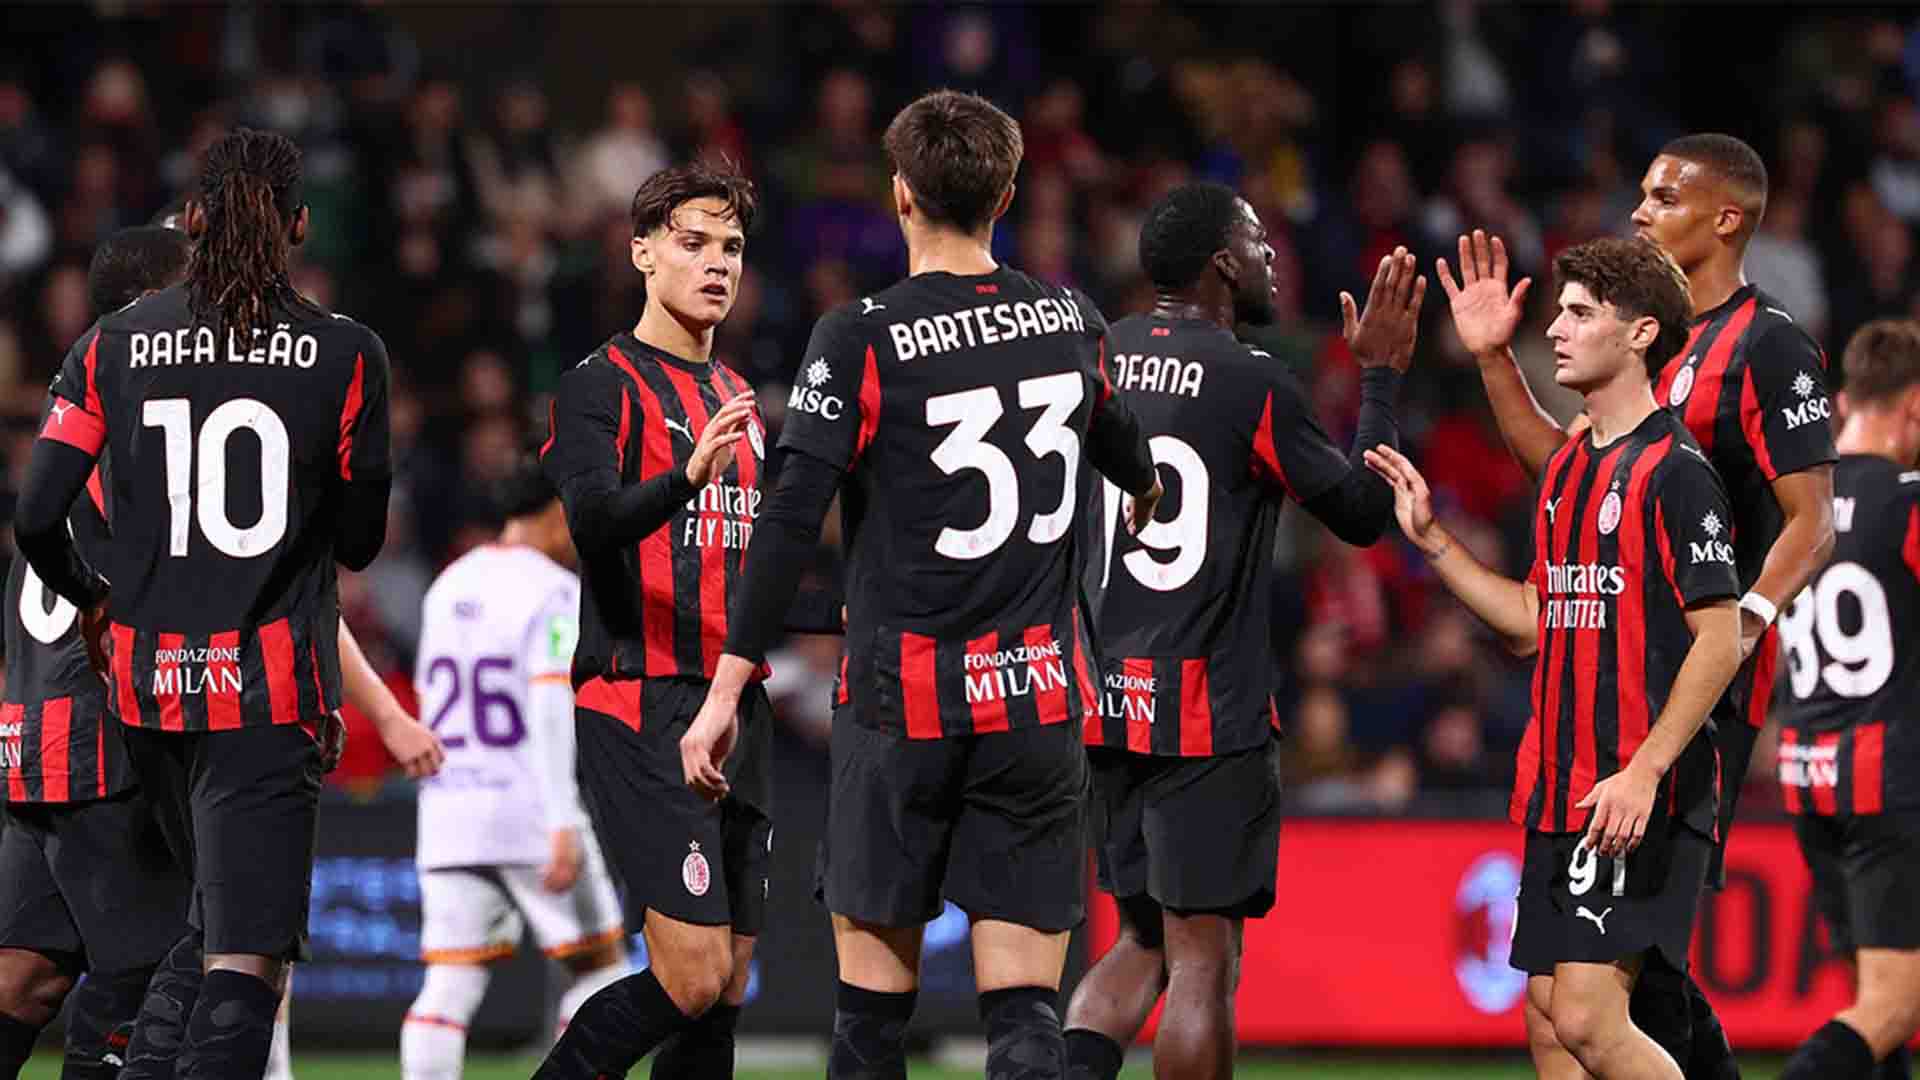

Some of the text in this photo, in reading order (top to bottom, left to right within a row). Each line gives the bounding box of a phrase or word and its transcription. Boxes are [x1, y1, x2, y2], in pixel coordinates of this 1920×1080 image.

[129, 322, 318, 369] RAFA LEÃO
[889, 297, 1086, 362] BARTESAGHI
[1114, 353, 1204, 398] OFANA
[787, 385, 843, 421] MSC
[1782, 396, 1832, 431] MSC
[142, 397, 290, 558] 10
[925, 370, 1085, 560] 33
[683, 517, 754, 551] FLY BETT
[1689, 540, 1736, 566] MSC
[1545, 557, 1625, 595] mirates
[155, 646, 241, 664] FONDAZIONE
[963, 639, 1062, 670] FONDAZIONE
[152, 666, 243, 695] MILAN
[964, 659, 1069, 704] MILAN
[427, 655, 527, 749] 26
[1567, 836, 1626, 897] 91
